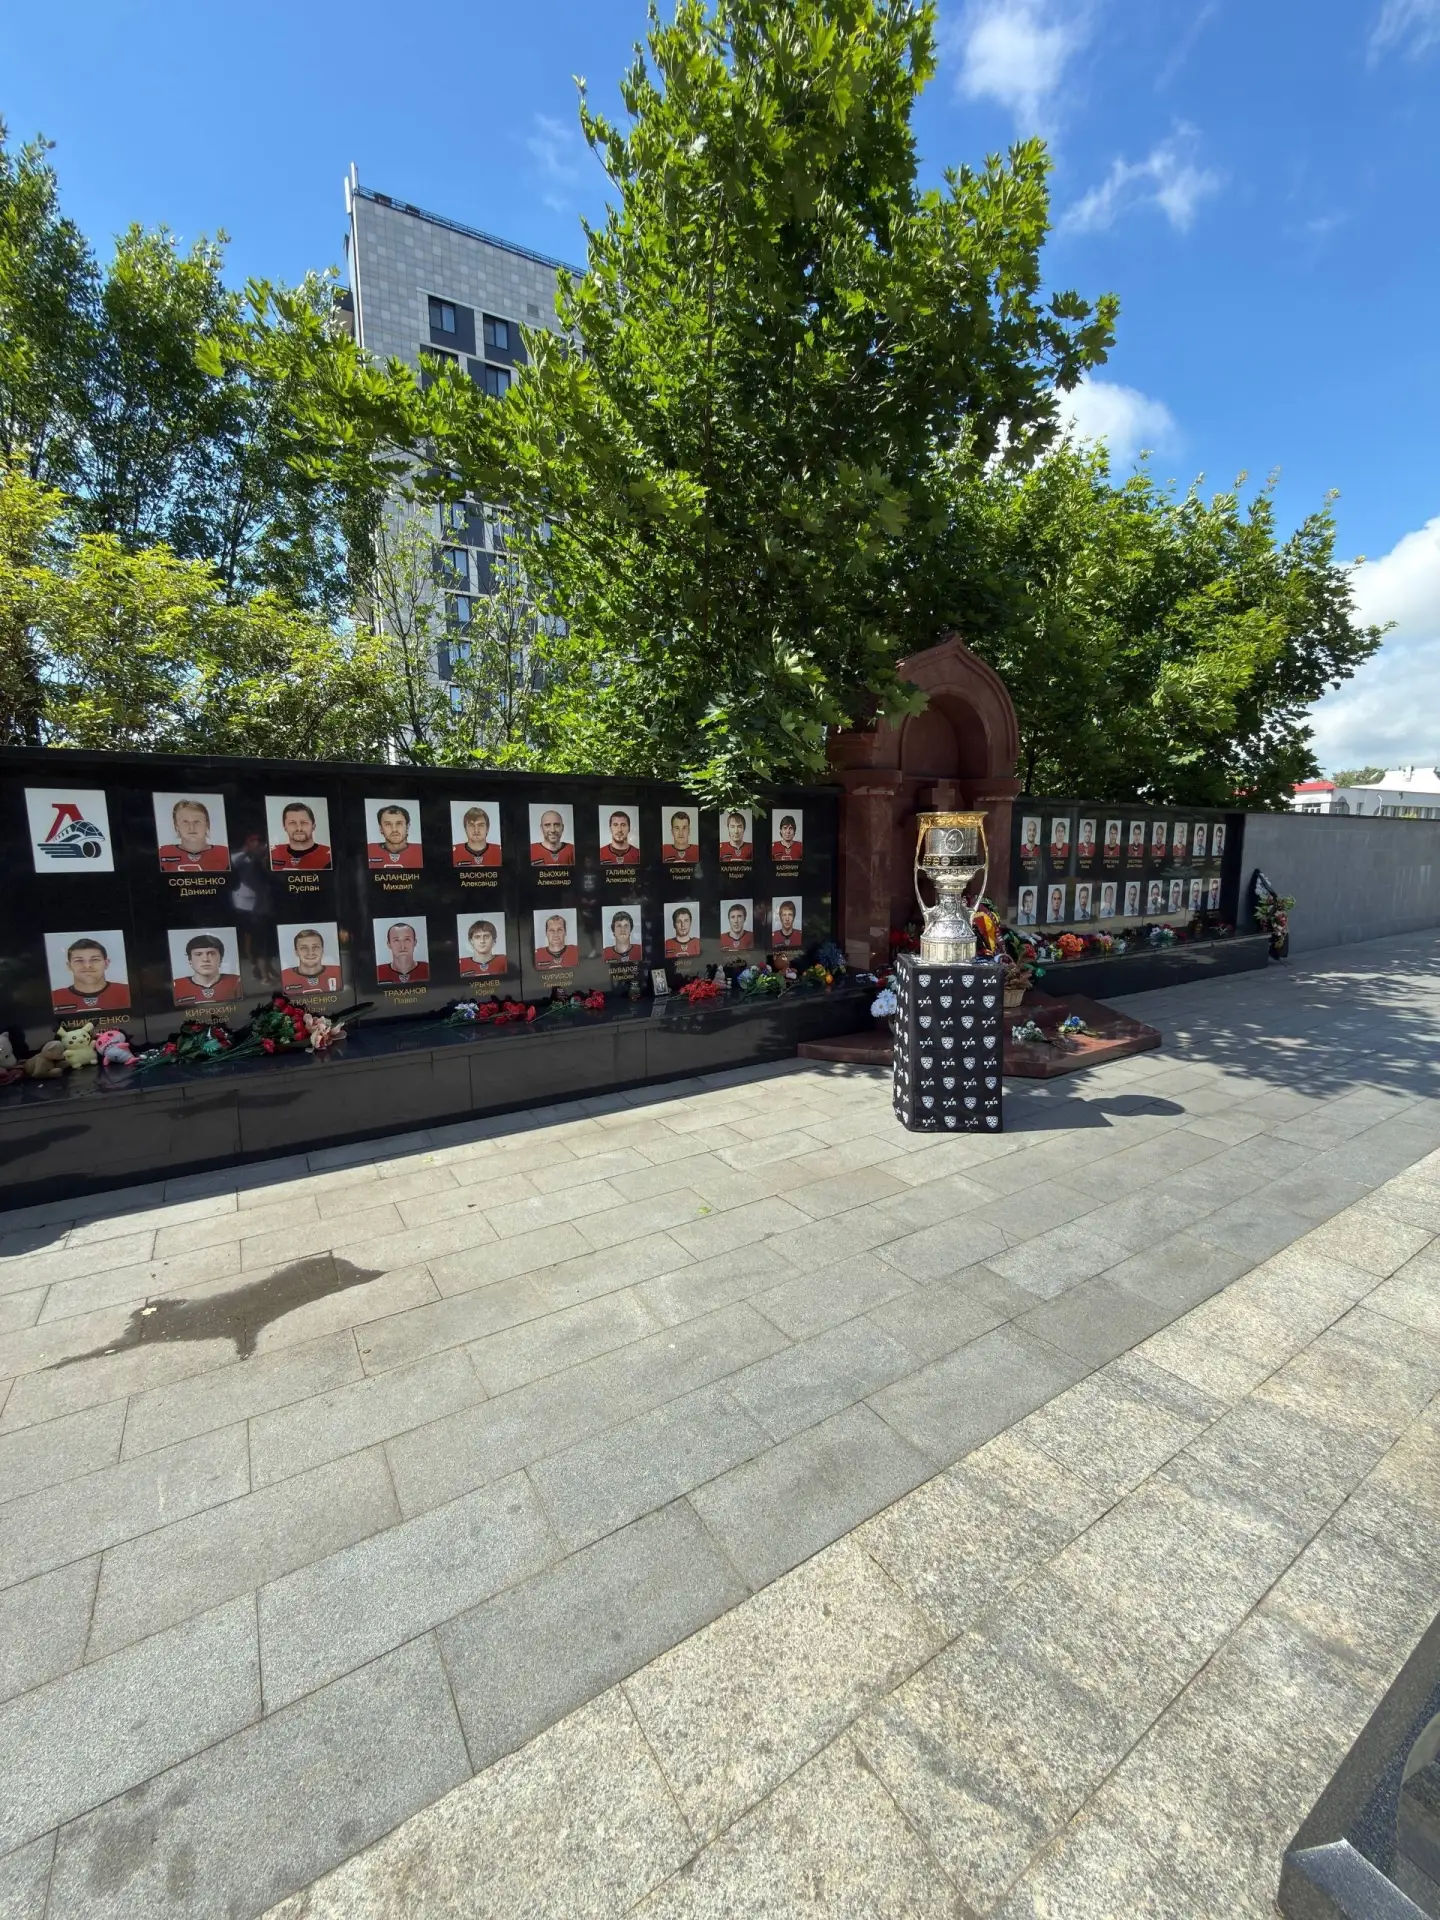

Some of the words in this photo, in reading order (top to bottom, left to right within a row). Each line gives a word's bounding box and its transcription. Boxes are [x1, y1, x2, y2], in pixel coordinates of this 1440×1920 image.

[287, 874, 319, 883] САЛЕЙ
[374, 873, 420, 881] БАЛАНДИН
[459, 871, 498, 879] ВАСЮНОВ
[168, 877, 226, 887] СОБЧЕНКО
[460, 880, 498, 888] Александр
[180, 888, 217, 897] Даниил
[288, 884, 320, 893] Руслан
[468, 979, 501, 988] УРЫЧЕВ
[383, 986, 427, 997] ТРАХАНОВ
[289, 995, 338, 1006] ТКАЧЕНКО
[185, 1005, 237, 1017] КИРЮХИН
[60, 1014, 131, 1029] АНИКЕНКО
